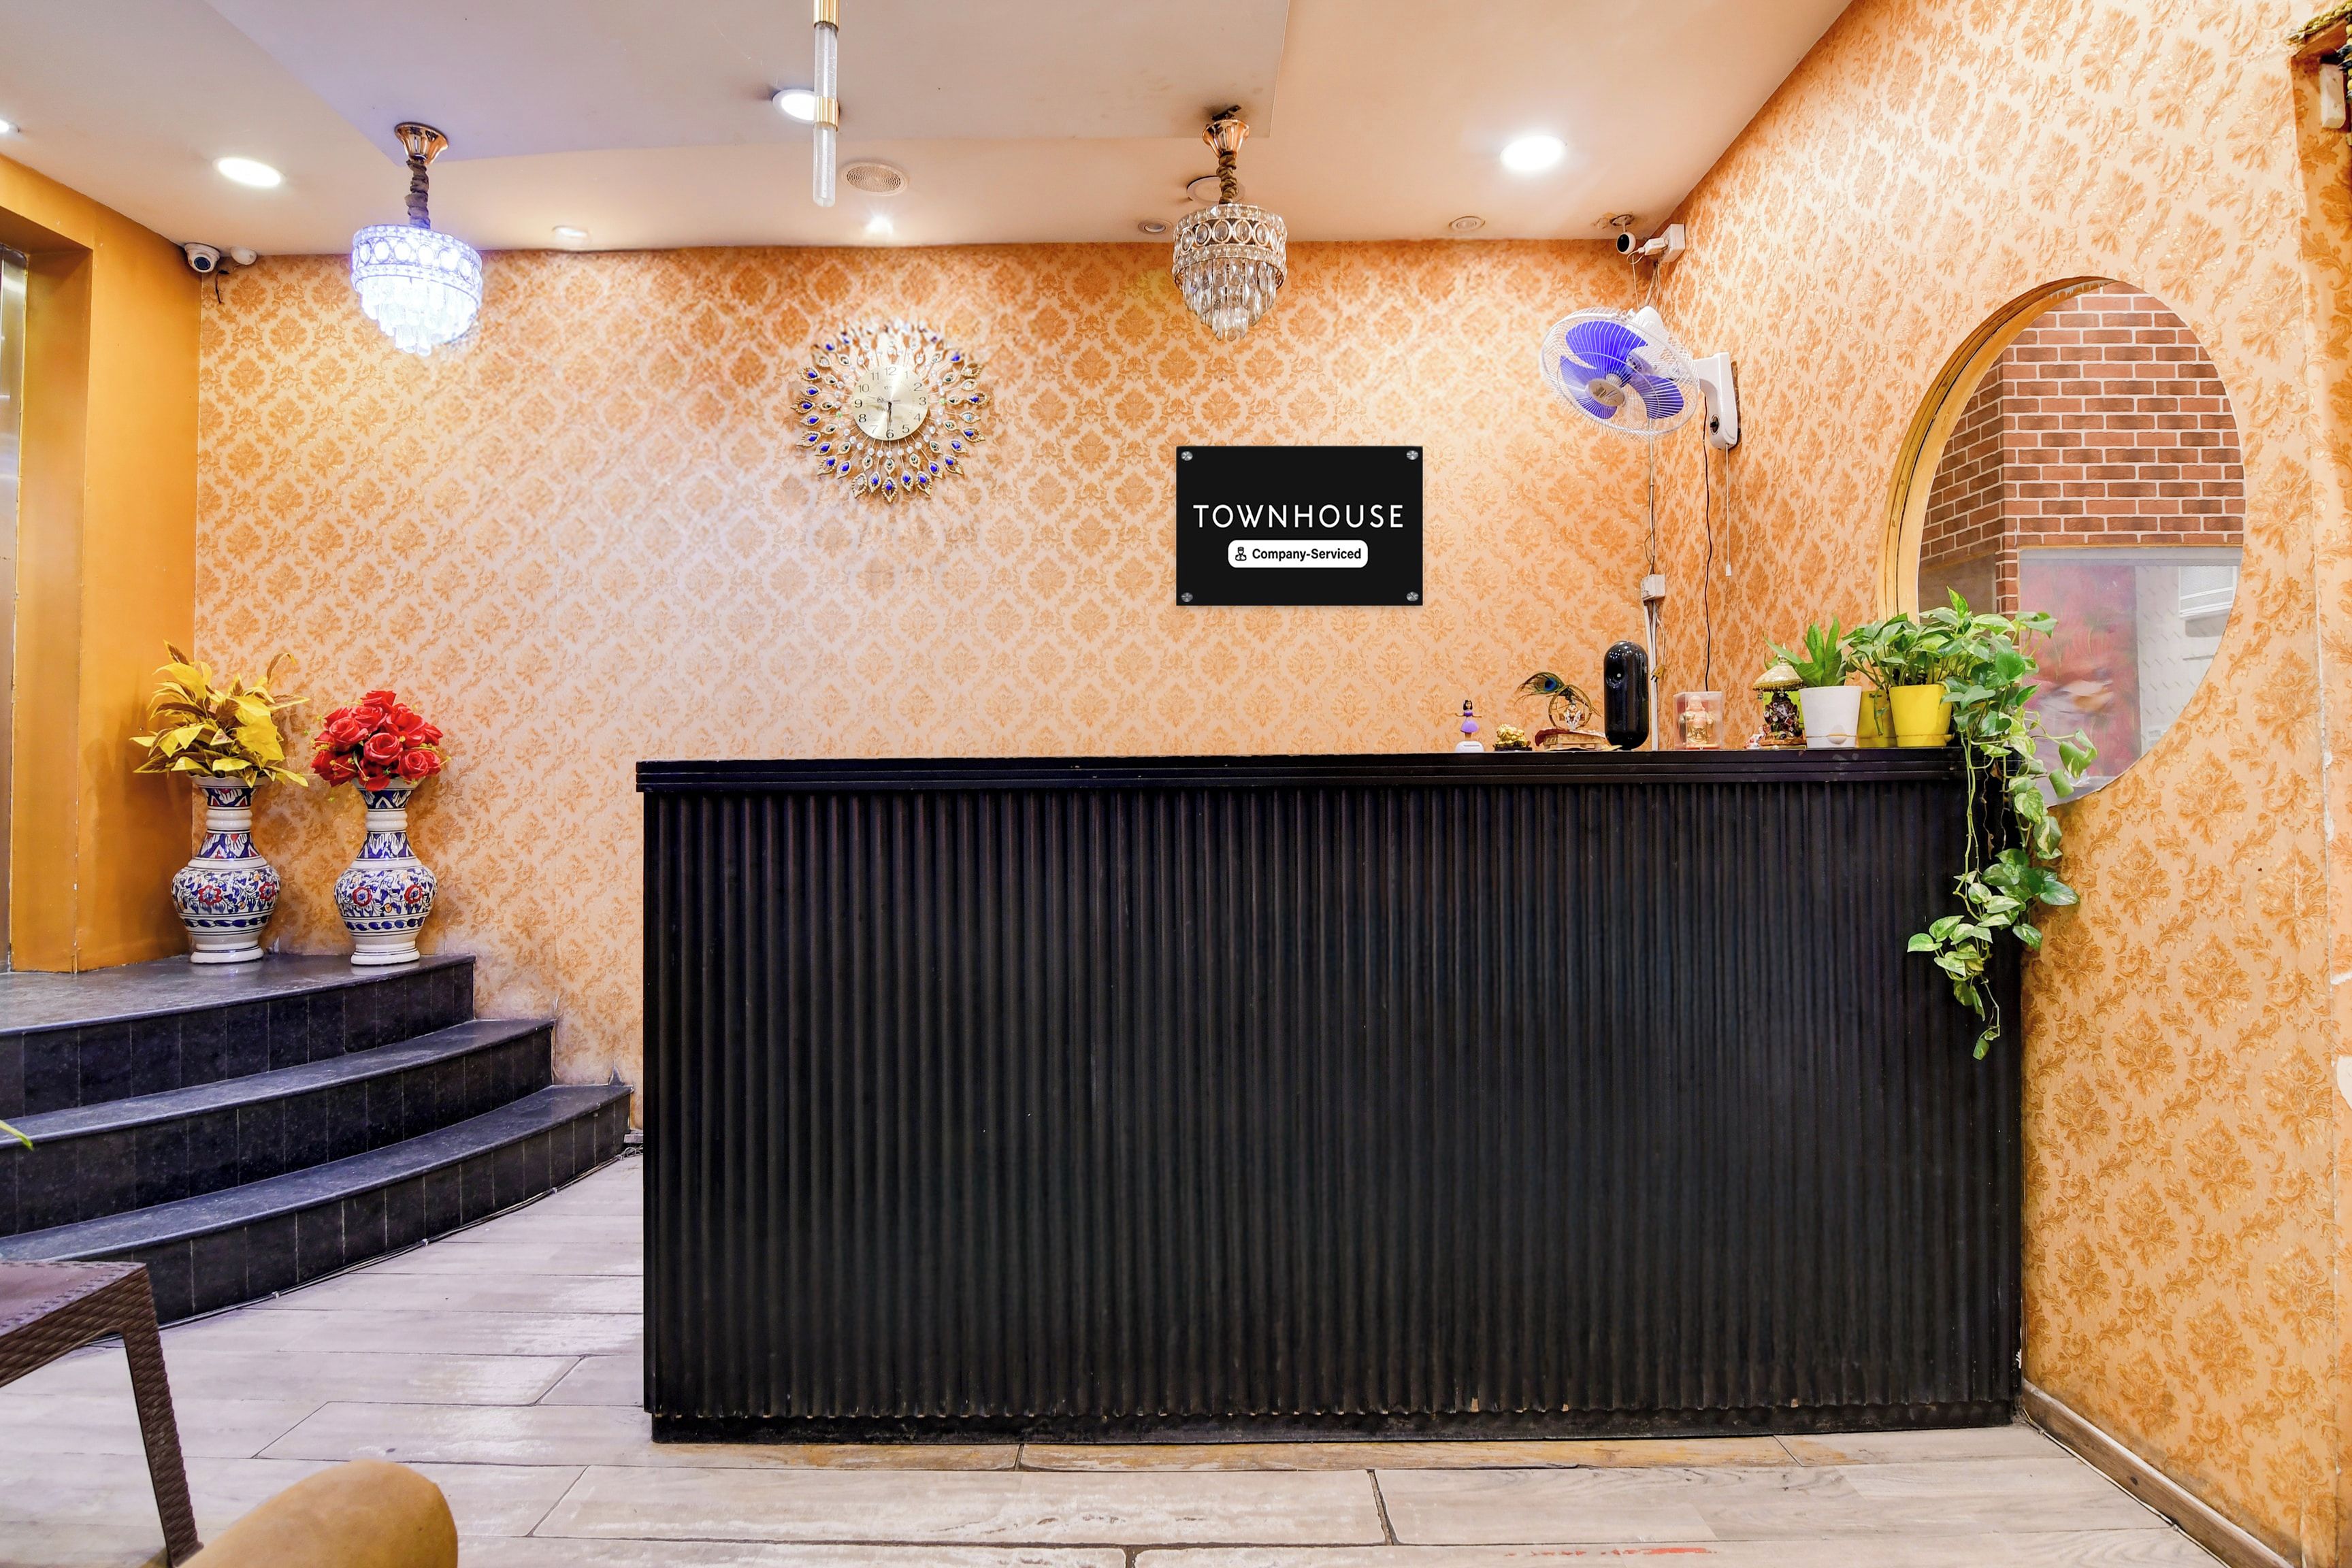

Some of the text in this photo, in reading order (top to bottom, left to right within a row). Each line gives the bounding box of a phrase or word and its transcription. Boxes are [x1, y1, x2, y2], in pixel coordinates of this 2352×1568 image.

[870, 372, 879, 380] 11
[884, 367, 897, 376] 12
[904, 371, 909, 379] 1
[859, 384, 870, 393] 10
[913, 382, 923, 391] 2
[854, 399, 863, 408] 9
[919, 397, 927, 406] 3
[858, 414, 867, 423] 8
[913, 413, 921, 422] 4
[870, 425, 878, 434] 7
[886, 429, 894, 438] 6
[902, 424, 910, 434] 5
[1192, 504, 1404, 529] TOWNHOUSE
[1252, 547, 1362, 562] Company-Serviced
